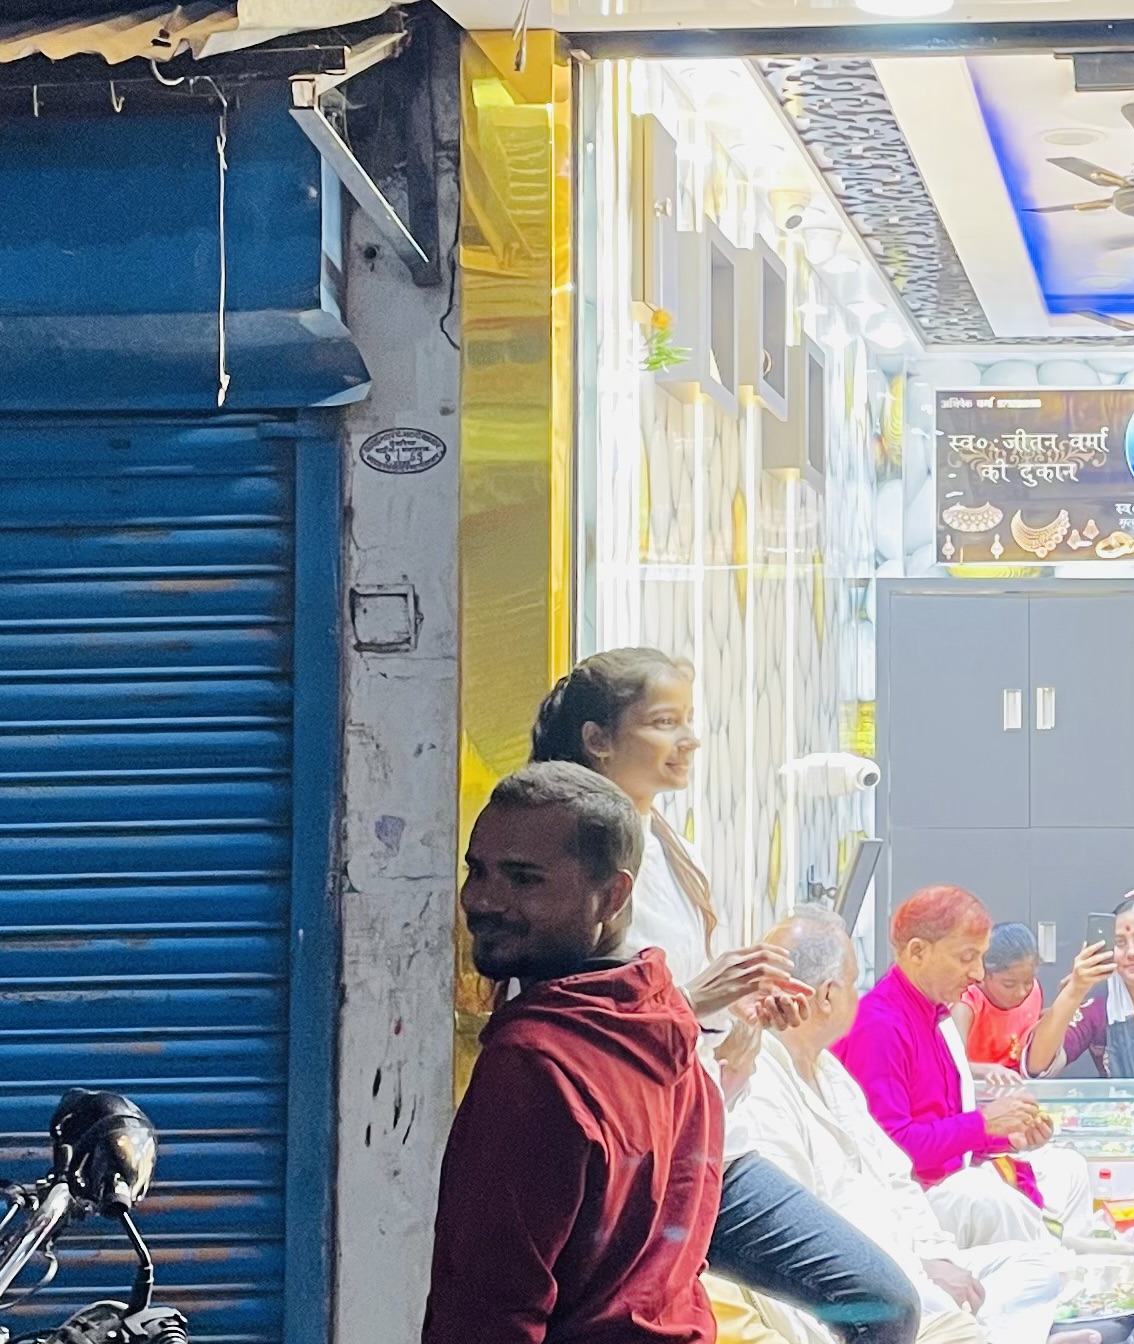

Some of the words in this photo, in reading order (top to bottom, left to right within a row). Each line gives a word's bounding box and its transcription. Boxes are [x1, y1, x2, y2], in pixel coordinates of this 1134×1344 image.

[1069, 427, 1109, 453] वर्मा
[981, 459, 1010, 483] की
[1018, 463, 1079, 487] दुकान
